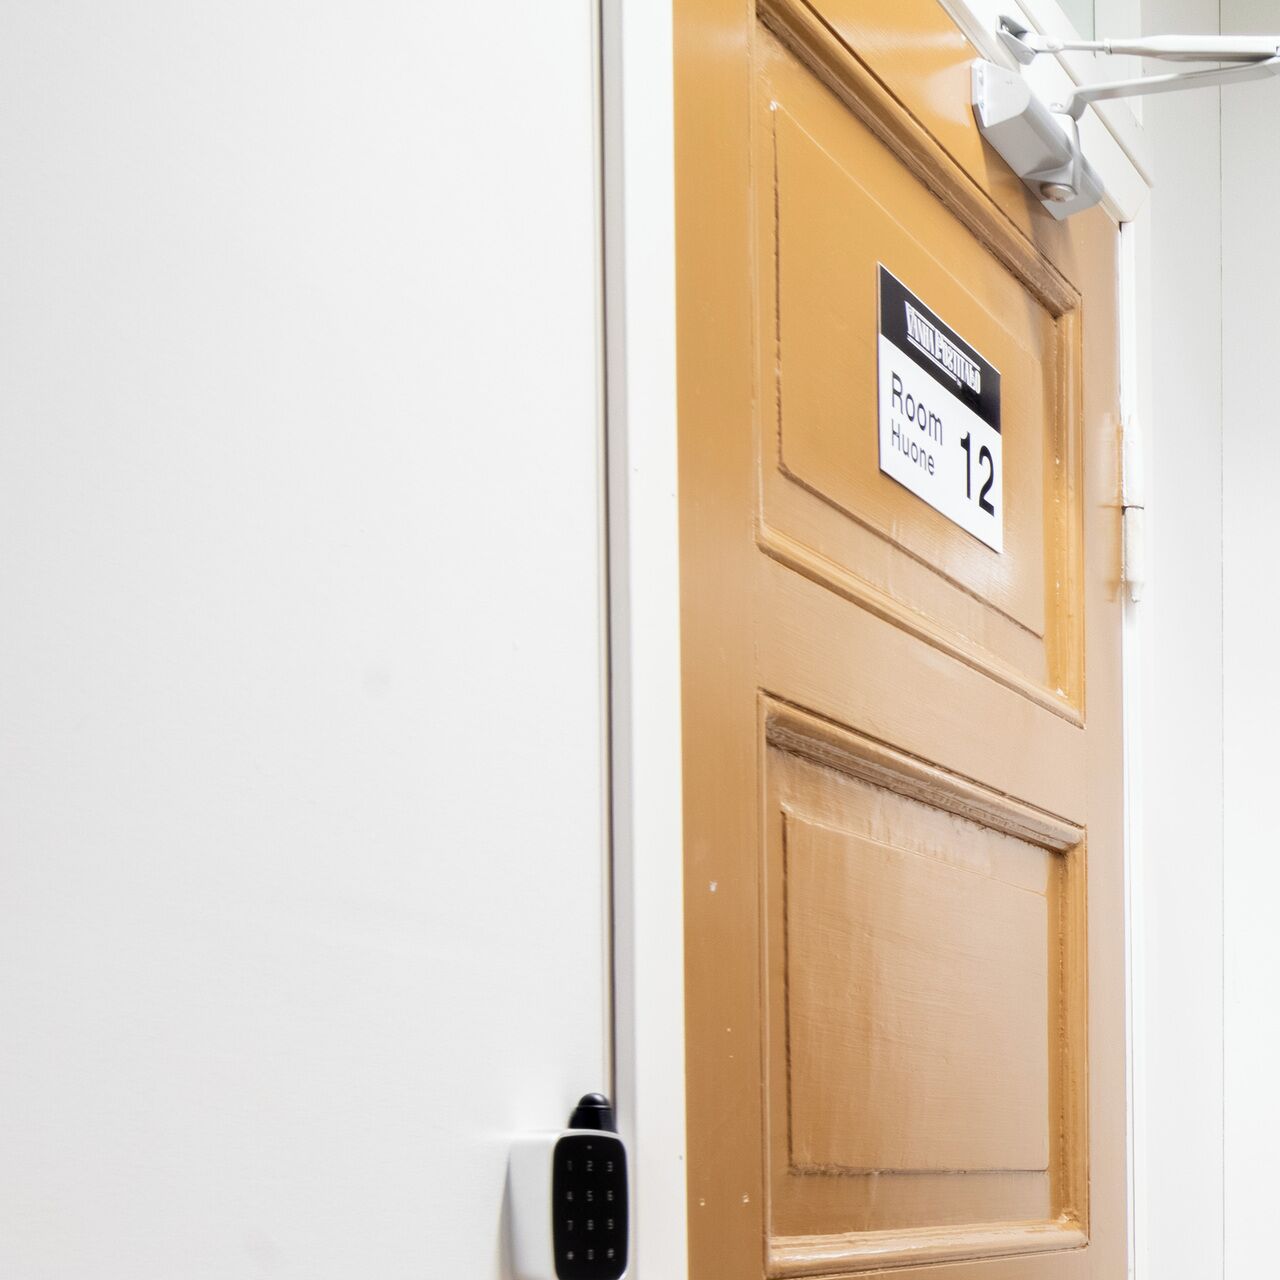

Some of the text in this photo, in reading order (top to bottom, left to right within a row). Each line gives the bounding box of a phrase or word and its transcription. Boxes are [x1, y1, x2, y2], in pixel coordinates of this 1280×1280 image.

[891, 370, 996, 518] Room 12
[891, 418, 936, 477] Huone
